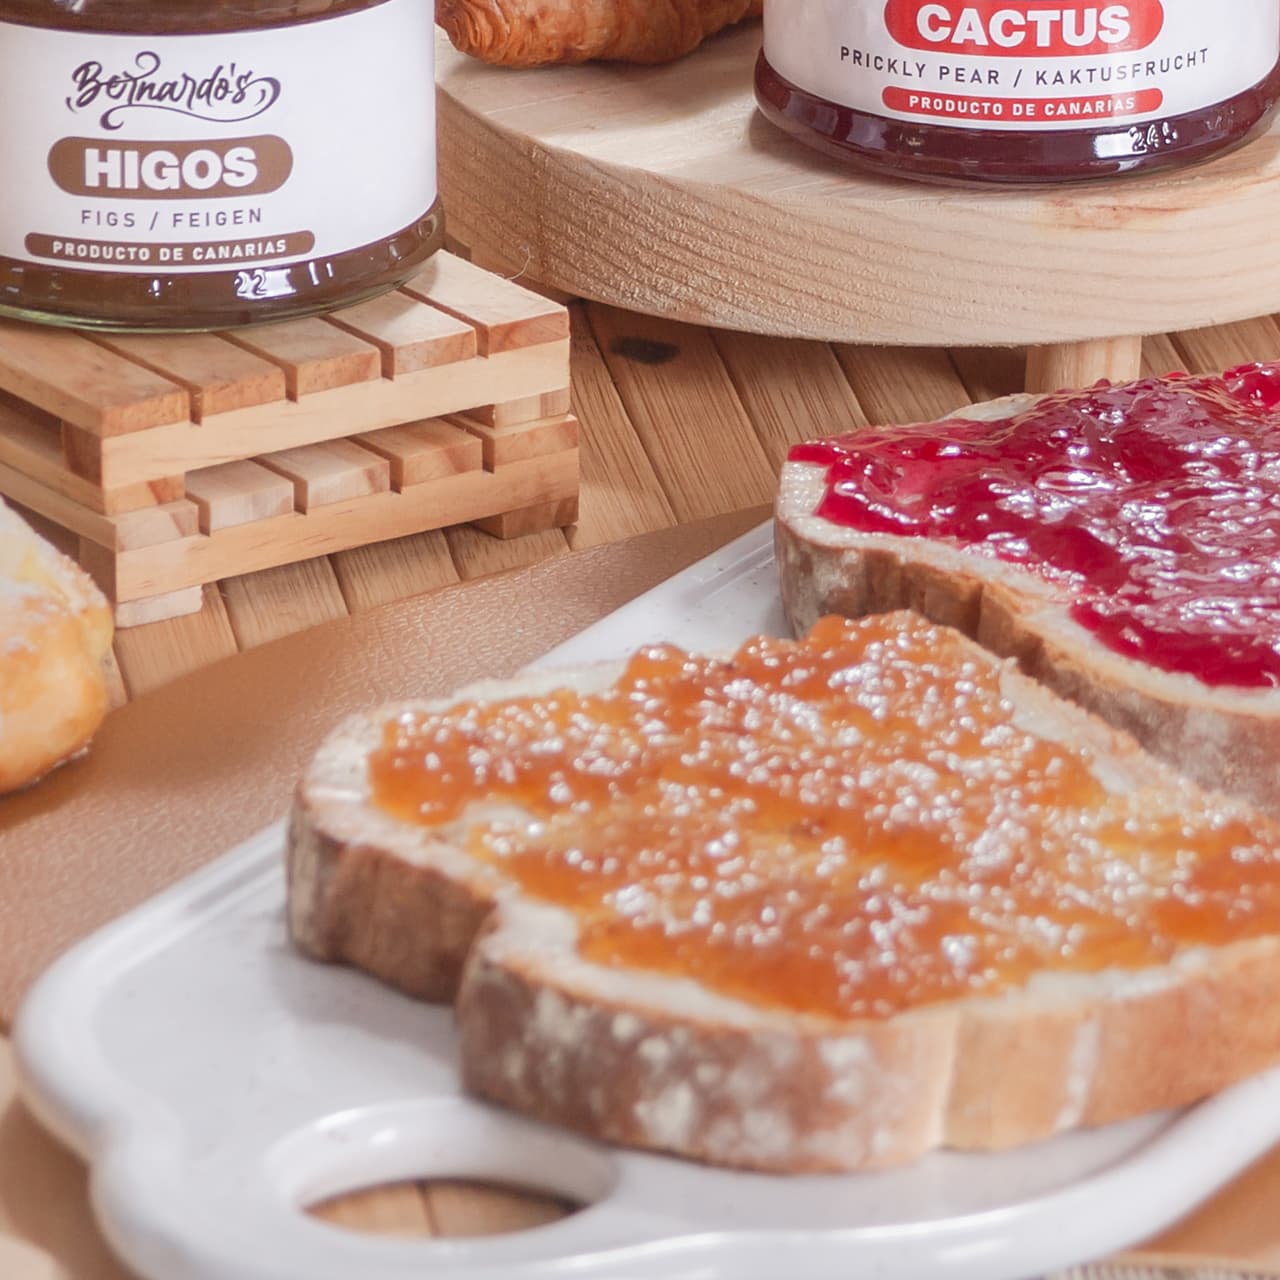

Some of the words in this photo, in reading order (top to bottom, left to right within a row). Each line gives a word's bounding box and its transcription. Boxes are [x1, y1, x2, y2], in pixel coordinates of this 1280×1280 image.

[916, 4, 1131, 48] CACTUS
[840, 46, 926, 78] PRICKLY
[939, 66, 1000, 85] PEAR
[1036, 48, 1208, 86] KAKTUSFRUCHT
[65, 51, 281, 130] Bernardo's
[909, 95, 1004, 116] PRODUCTO
[1012, 102, 1036, 117] DE
[1044, 96, 1136, 117] CANARIAS
[84, 146, 259, 191] HIGOS
[81, 210, 136, 227] FIGS
[172, 208, 262, 228] FEIGEN
[52, 240, 151, 262] PRODUCTO
[159, 245, 184, 262] DE
[192, 239, 288, 261] CANARIAS
